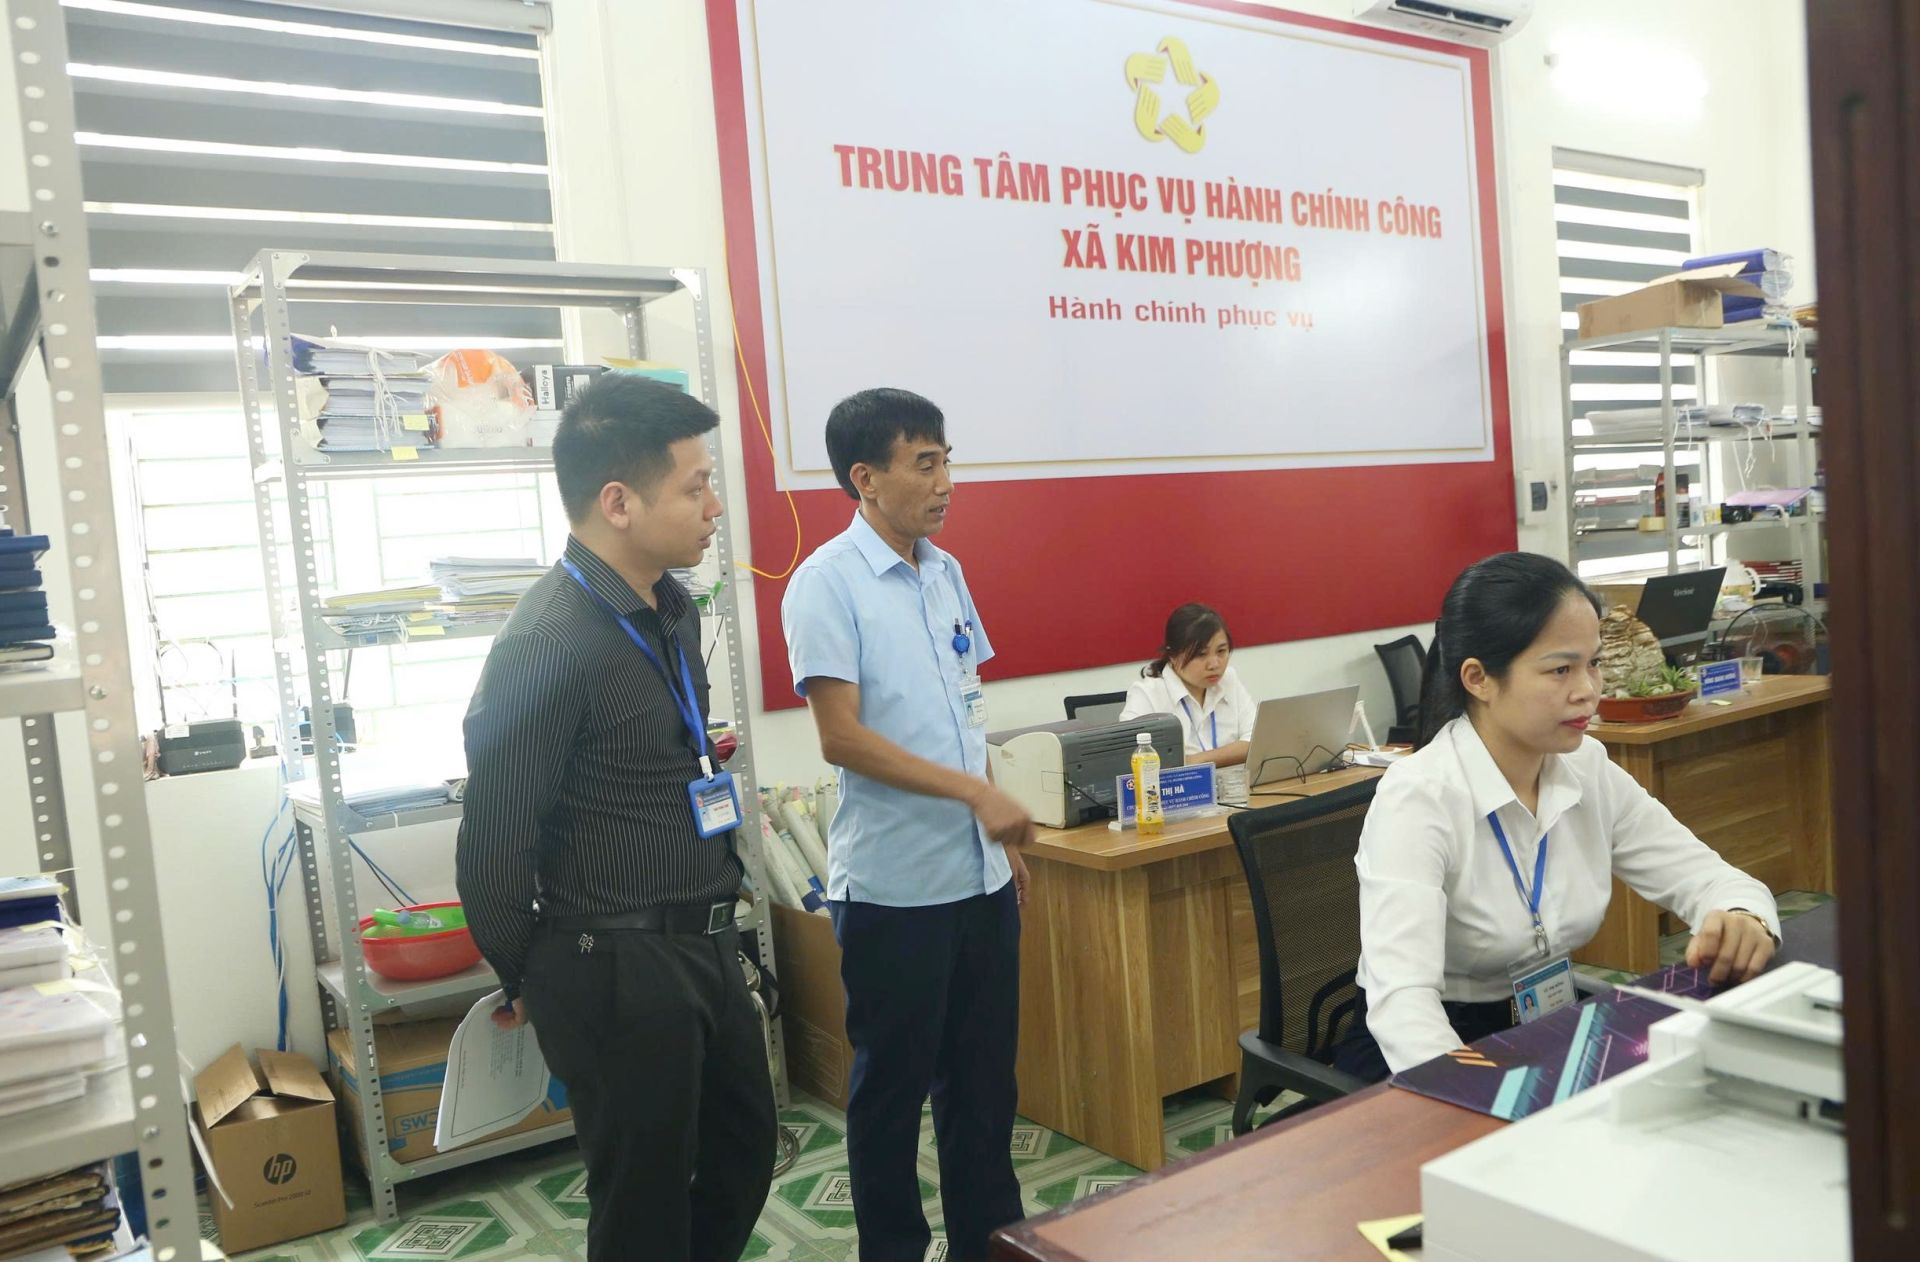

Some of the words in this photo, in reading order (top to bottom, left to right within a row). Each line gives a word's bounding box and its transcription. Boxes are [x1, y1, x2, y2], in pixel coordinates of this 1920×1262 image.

[833, 143, 964, 197] TRUNG
[973, 151, 1051, 203] TÂM
[1060, 165, 1148, 218] PHỤC
[1156, 176, 1197, 224] VỤ
[1204, 176, 1283, 224] HÀNH
[1290, 187, 1370, 232] CHÍNH
[1377, 195, 1443, 239] CÔNG
[1060, 223, 1108, 270] XÃ
[1115, 232, 1177, 274] KIM
[1184, 239, 1303, 288] PHƯỢNG
[1048, 295, 1122, 321] Hành
[1134, 300, 1206, 324] chính
[1217, 304, 1277, 330] phục
[1286, 311, 1315, 332] vụ
[266, 1153, 294, 1185] hp
